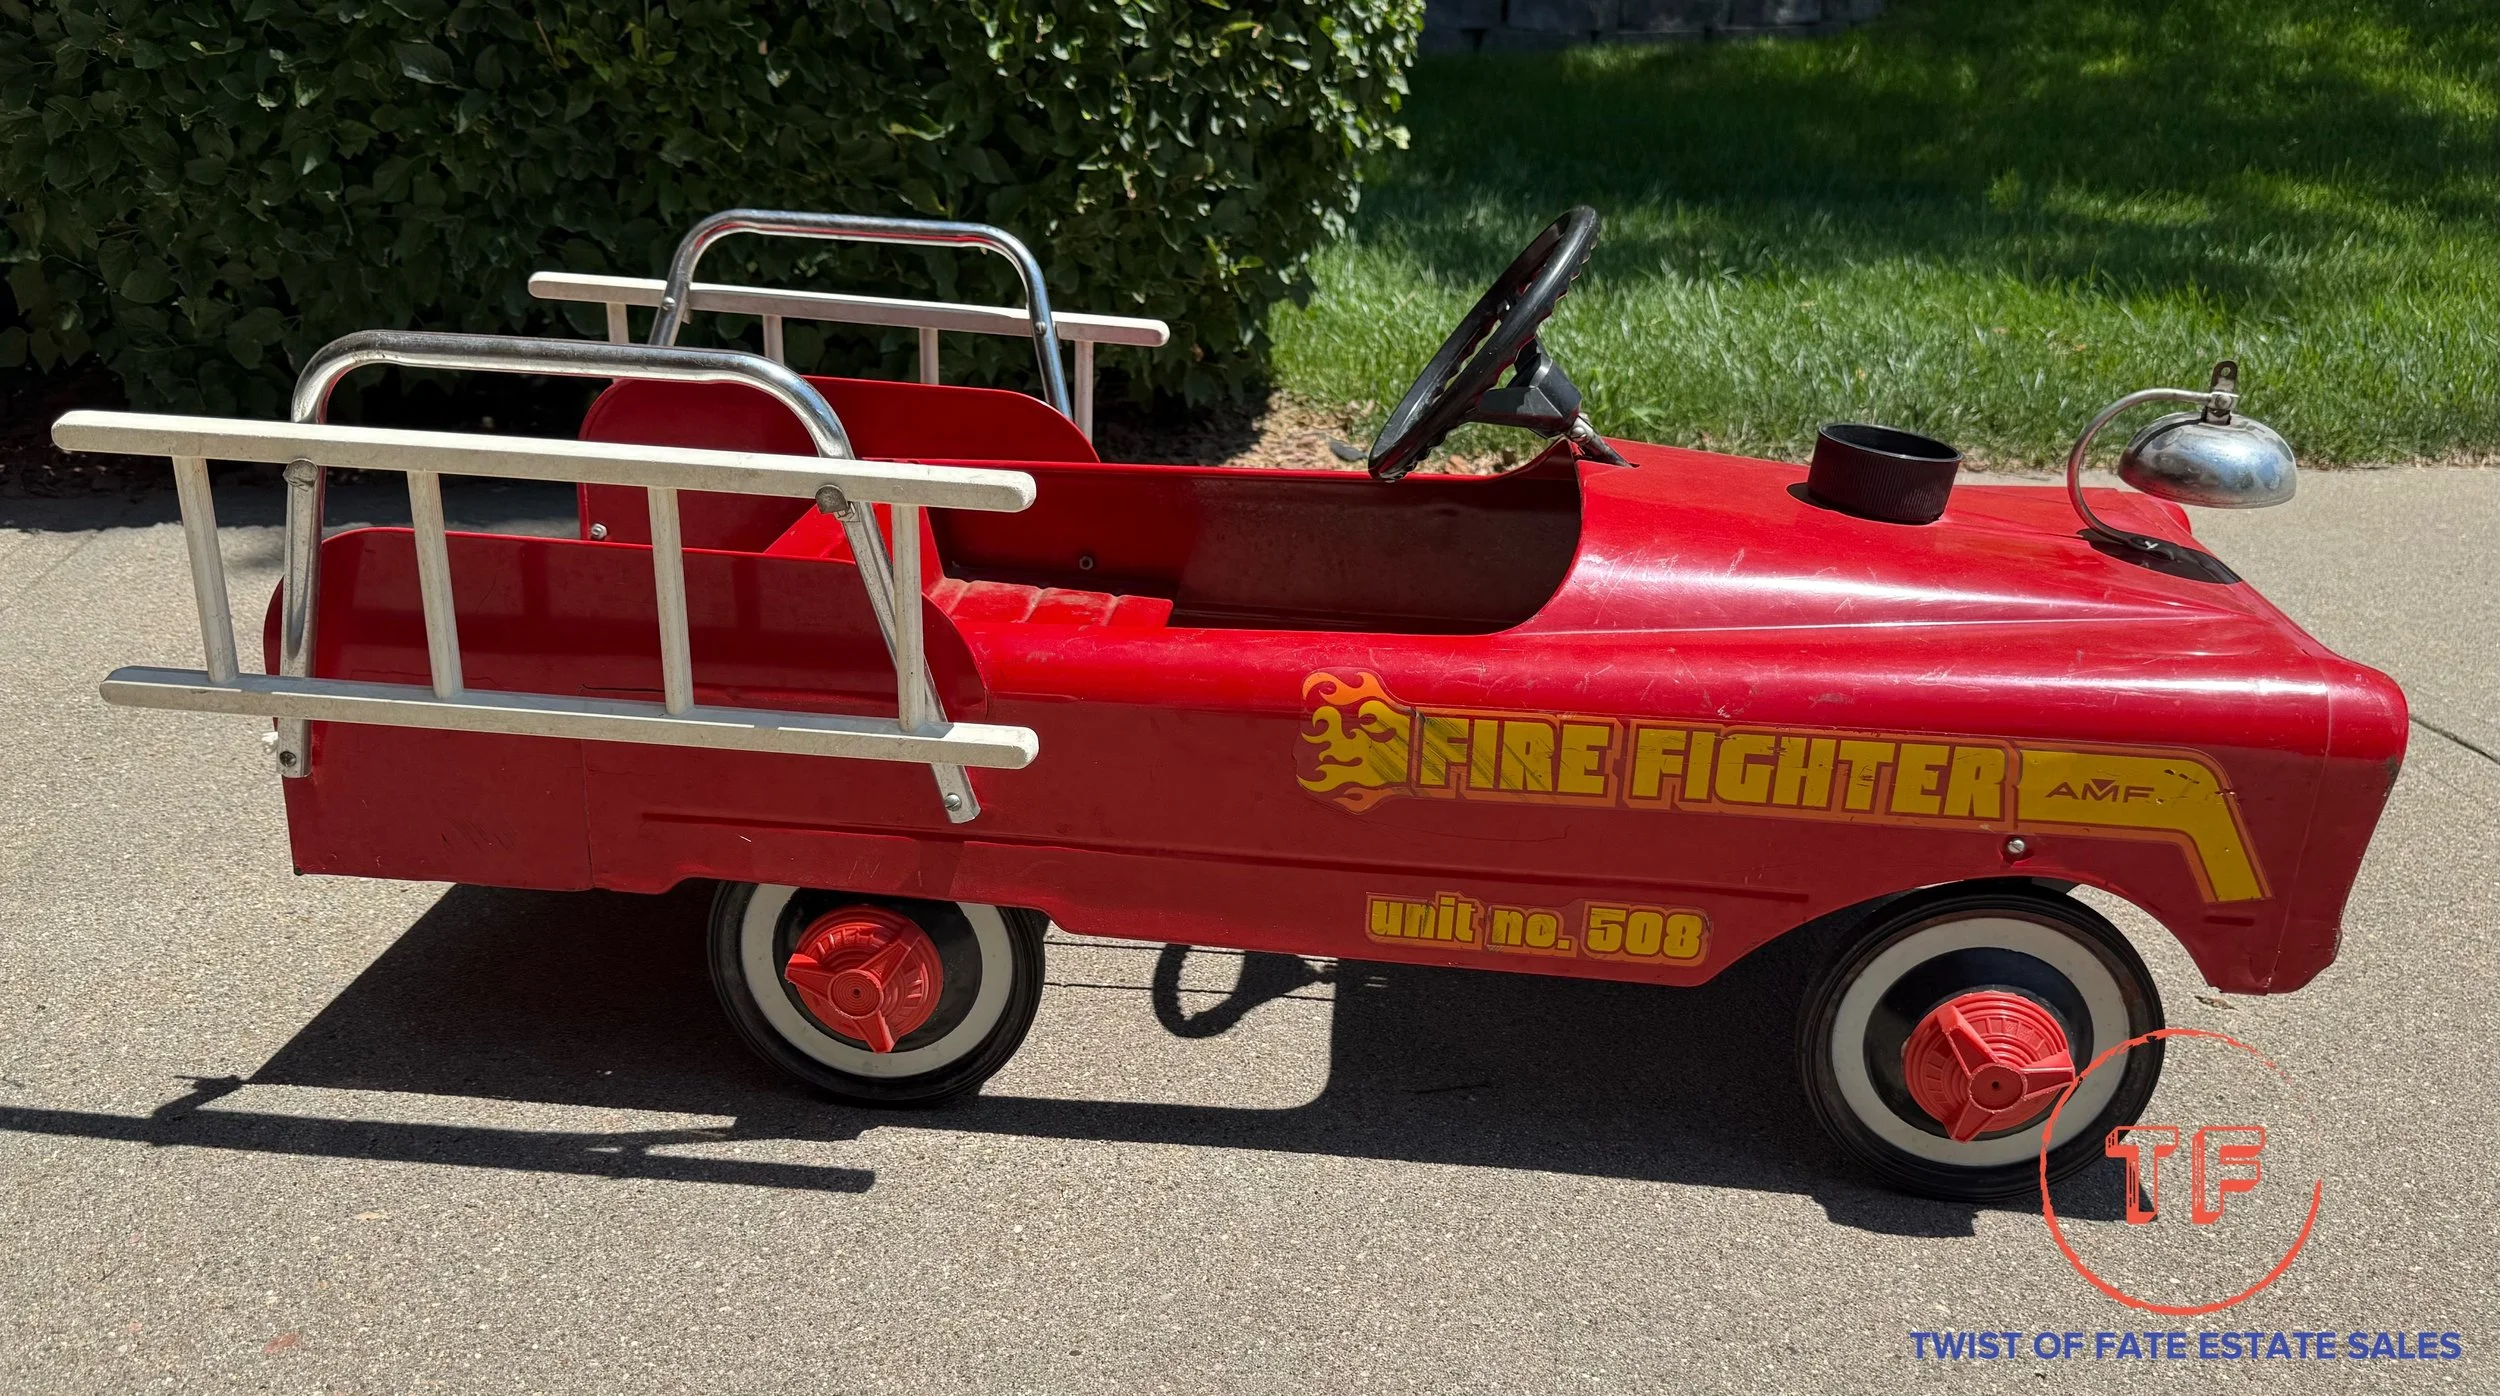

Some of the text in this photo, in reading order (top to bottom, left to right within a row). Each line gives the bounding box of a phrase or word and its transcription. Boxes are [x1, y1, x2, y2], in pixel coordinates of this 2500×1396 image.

[1419, 716, 2006, 822] FIRE FIGHTER
[2045, 778, 2156, 804] AMF
[1371, 897, 1703, 959] unit no. 508
